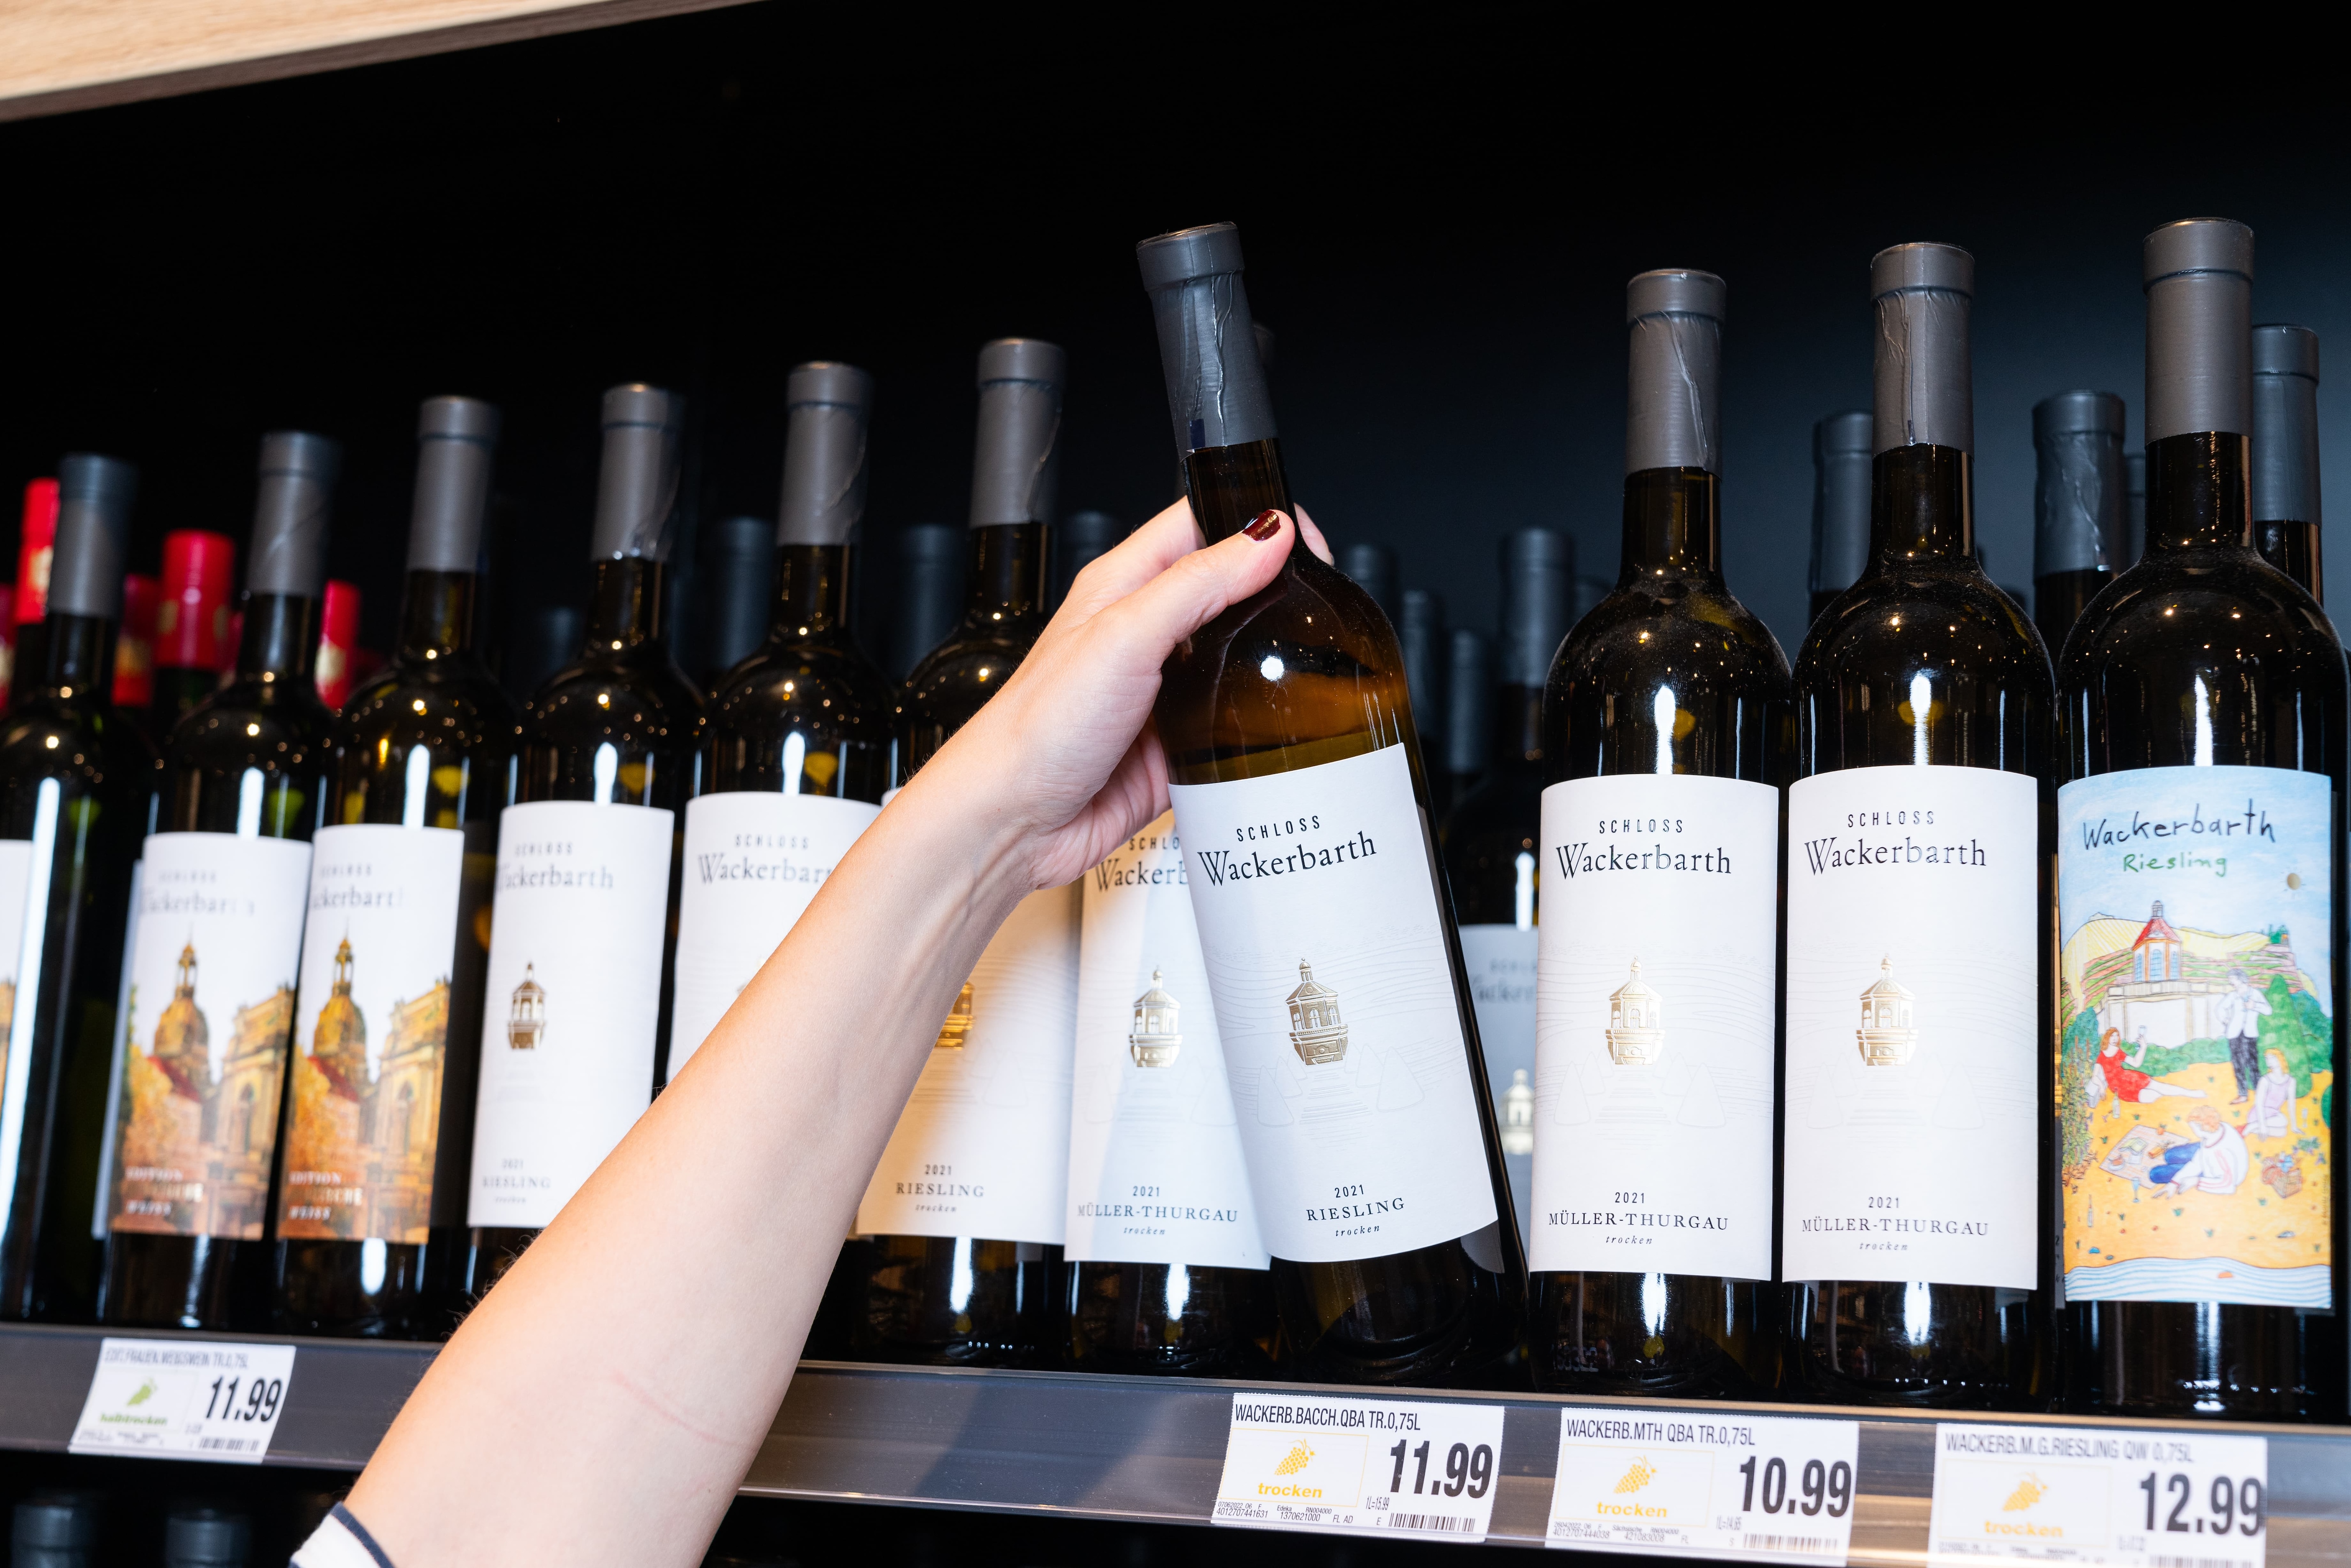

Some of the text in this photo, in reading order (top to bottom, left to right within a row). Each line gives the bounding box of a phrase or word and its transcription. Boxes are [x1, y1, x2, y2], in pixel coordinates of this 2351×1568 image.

[1599, 819, 1683, 834] SCHLOSS
[1848, 811, 1934, 828] SCHLOSS
[2083, 798, 2276, 850] Wackerbarth
[1237, 815, 1320, 842] SCHLOSS
[734, 834, 809, 849] SCHLOSS
[1129, 836, 1180, 851] SCHLO
[1197, 831, 1377, 887] Wackerbarth
[1556, 842, 1731, 880] Wackerbarth
[1804, 836, 1986, 876] Wackerbarth
[2123, 851, 2228, 877] Riesling
[698, 853, 832, 884] Wackerbar
[1095, 858, 1188, 892] Wackerb
[924, 1164, 953, 1176] 2021
[895, 1182, 985, 1198] RIESLING
[1132, 1186, 1160, 1197] 2021
[1334, 1184, 1365, 1198] 2021
[1615, 1192, 1645, 1204] 2021
[915, 1203, 957, 1213] trocken
[1306, 1197, 1405, 1221] RIESLING
[1868, 1197, 1900, 1209] 2021
[1077, 1202, 1238, 1222] MÜLLER-THURGAU
[1549, 1210, 1728, 1230] MÜLLER-THURGAU
[1123, 1226, 1166, 1235] trocken
[1335, 1224, 1381, 1237] trocken
[1802, 1216, 1988, 1236] MÜLLER-THURGAU
[1606, 1235, 1653, 1245] trocken
[1859, 1241, 1909, 1251] trocken
[206, 1375, 282, 1422] 11.99
[1235, 1403, 1421, 1433] WACKERB.BACCH.QBA TR.0,75L
[1567, 1419, 1756, 1448] WACKERB.MTH QBA TR.0,75L
[1390, 1439, 1493, 1499] 11.99
[1258, 1482, 1322, 1498] trocken
[1740, 1455, 1852, 1518] 10.99
[1366, 1496, 1389, 1511] 1L=15.99
[1596, 1501, 1667, 1518] trocken
[2140, 1471, 2265, 1536] 12.99
[1216, 1508, 1268, 1518] 4012707441631
[1280, 1512, 1320, 1521] 1370621000
[1984, 1521, 2064, 1538] trocken
